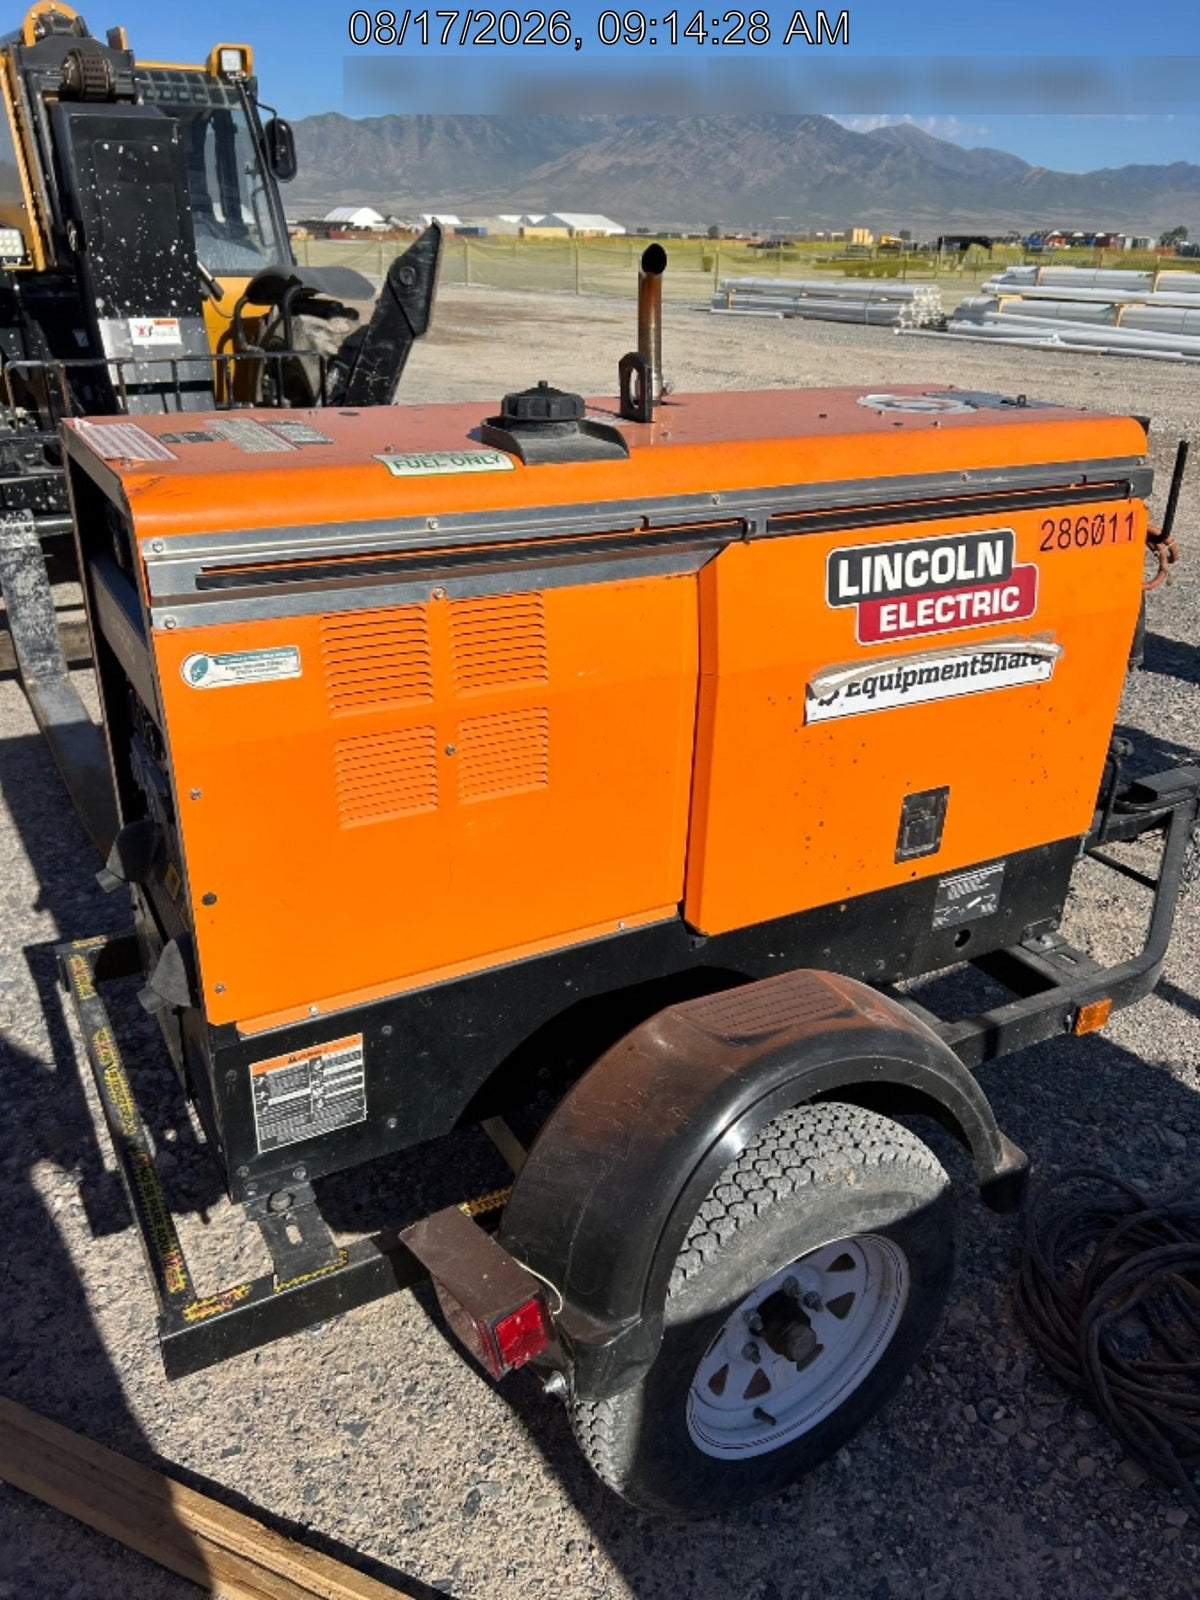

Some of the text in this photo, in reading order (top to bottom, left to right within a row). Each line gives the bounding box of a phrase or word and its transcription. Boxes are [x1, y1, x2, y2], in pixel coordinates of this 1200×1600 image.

[393, 454, 501, 470] FUEL ONLY
[1040, 511, 1134, 551] 286011
[838, 540, 1005, 598] LINCOLN
[879, 586, 1021, 633] ELECTRIC
